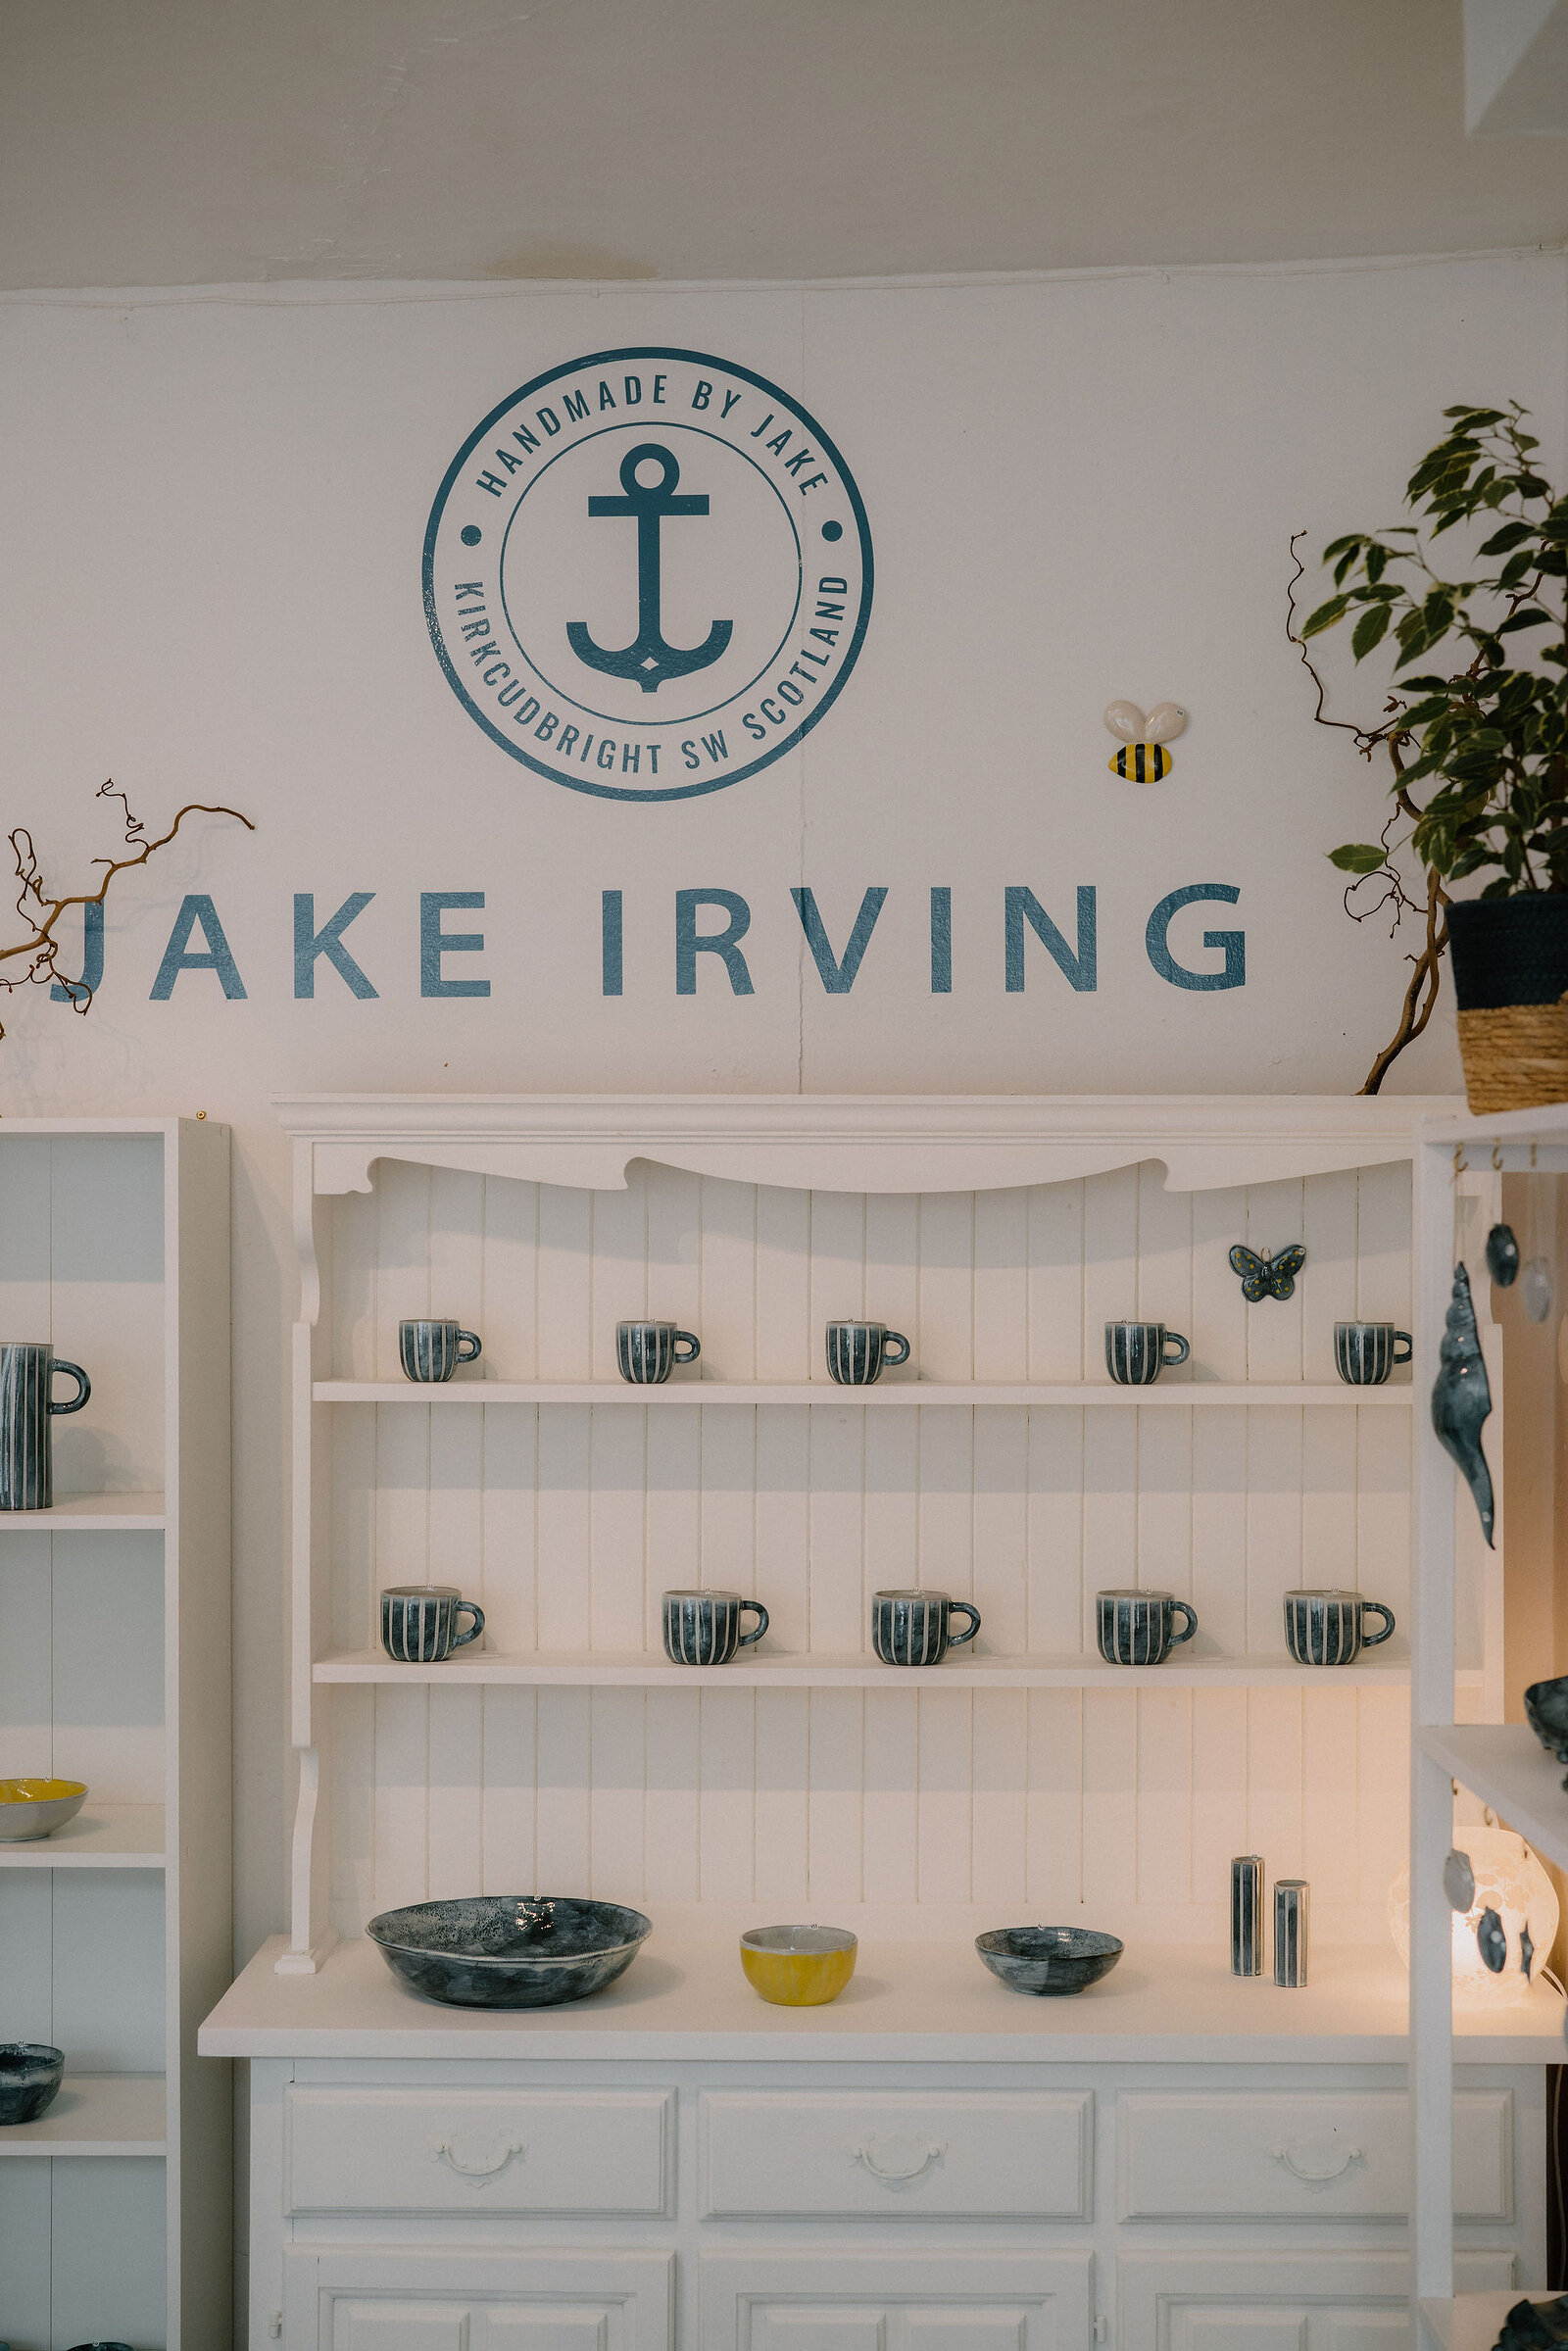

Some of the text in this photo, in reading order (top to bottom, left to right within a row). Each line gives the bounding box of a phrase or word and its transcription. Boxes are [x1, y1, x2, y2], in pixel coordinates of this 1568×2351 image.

[475, 374, 830, 499] HANDMADE BY JAKE
[454, 575, 849, 775] KIRKCUDBRIGHT SW SCOTLAND
[49, 882, 1247, 1003] JAKE IRVING
